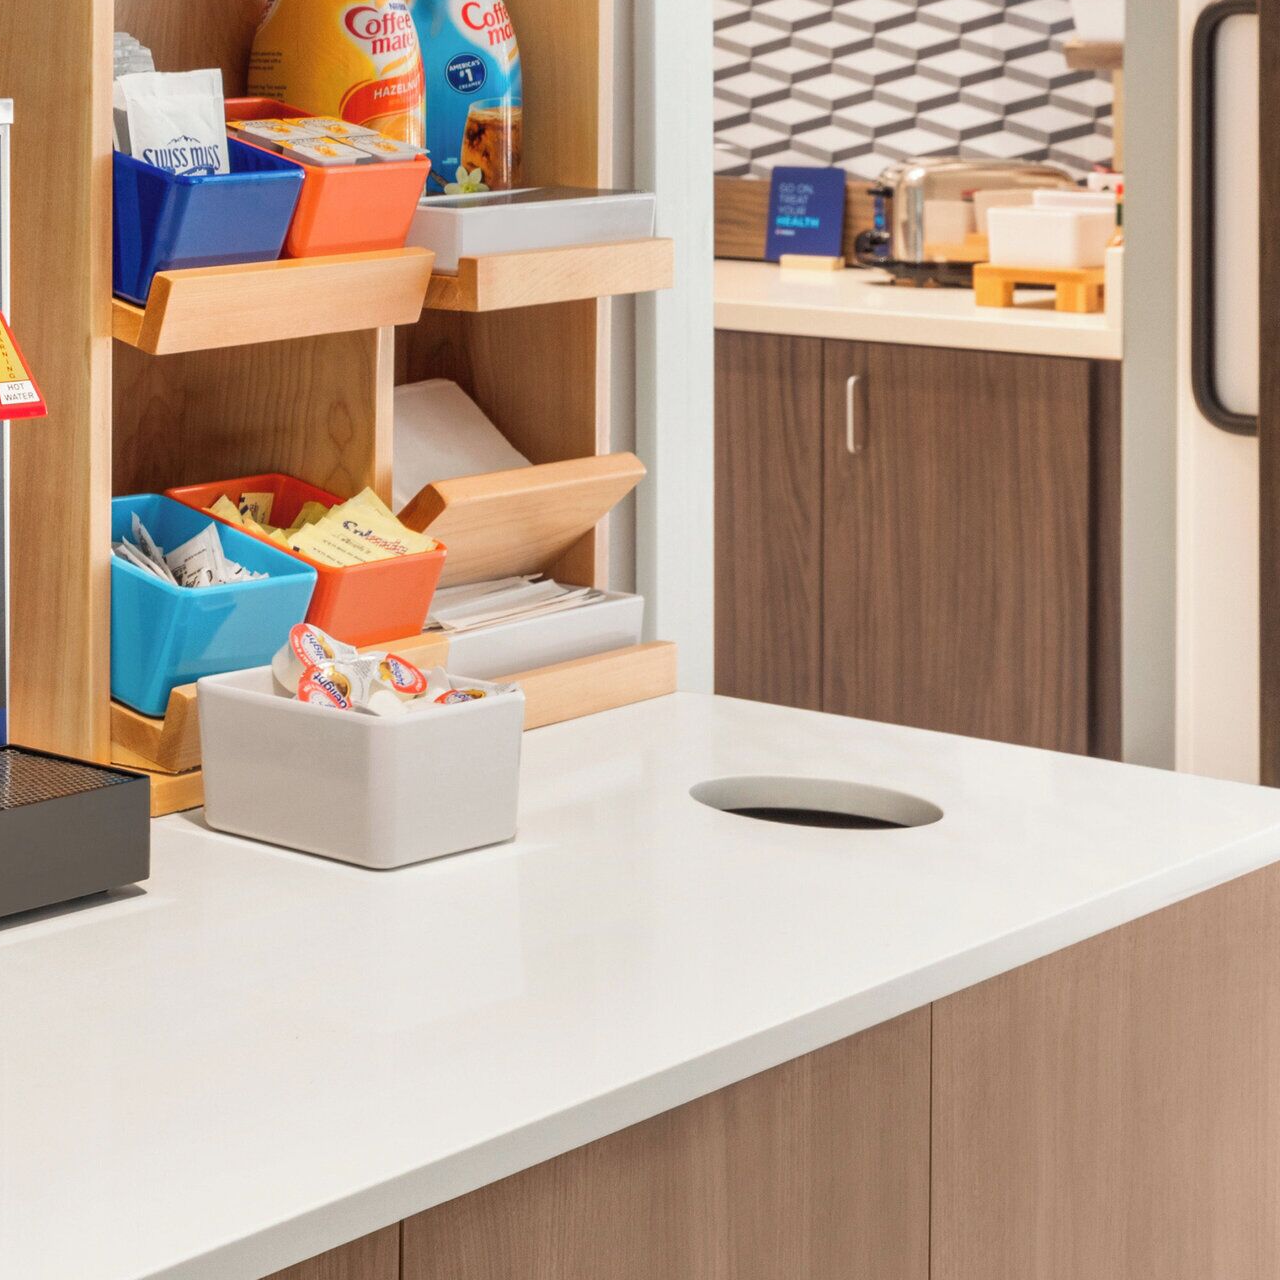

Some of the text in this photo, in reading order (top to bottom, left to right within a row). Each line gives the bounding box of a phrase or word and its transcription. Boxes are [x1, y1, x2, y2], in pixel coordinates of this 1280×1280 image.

[344, 6, 412, 40] Coffee
[448, 59, 480, 72] AMERICA'S
[776, 215, 820, 228] HEALTH
[7, 382, 25, 391] HOT
[4, 391, 35, 402] WATER
[312, 671, 348, 710] delight
